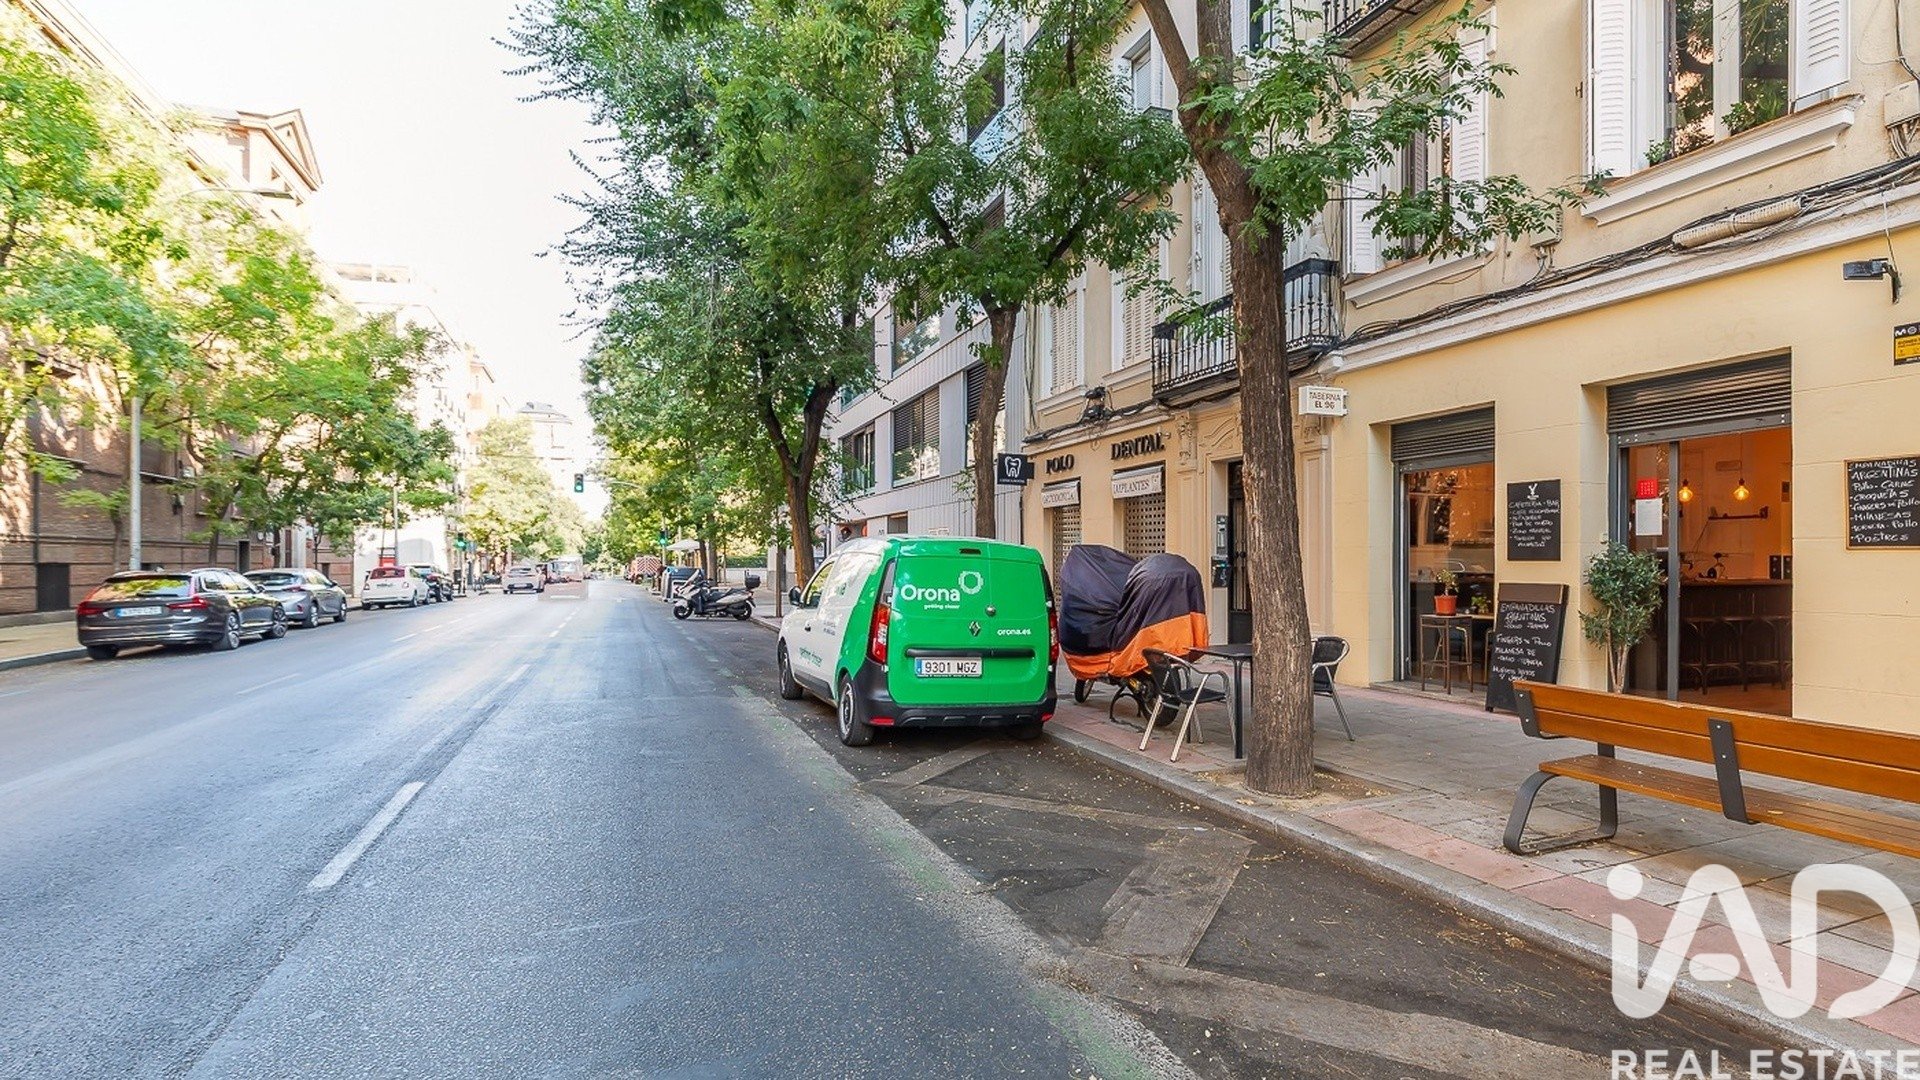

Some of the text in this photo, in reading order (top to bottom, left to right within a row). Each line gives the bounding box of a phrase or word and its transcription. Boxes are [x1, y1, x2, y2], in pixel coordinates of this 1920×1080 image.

[1046, 432, 1166, 475] POLO DENTAL
[900, 584, 961, 602] Orona
[997, 628, 1032, 636] orona.es
[925, 661, 951, 673] 9301
